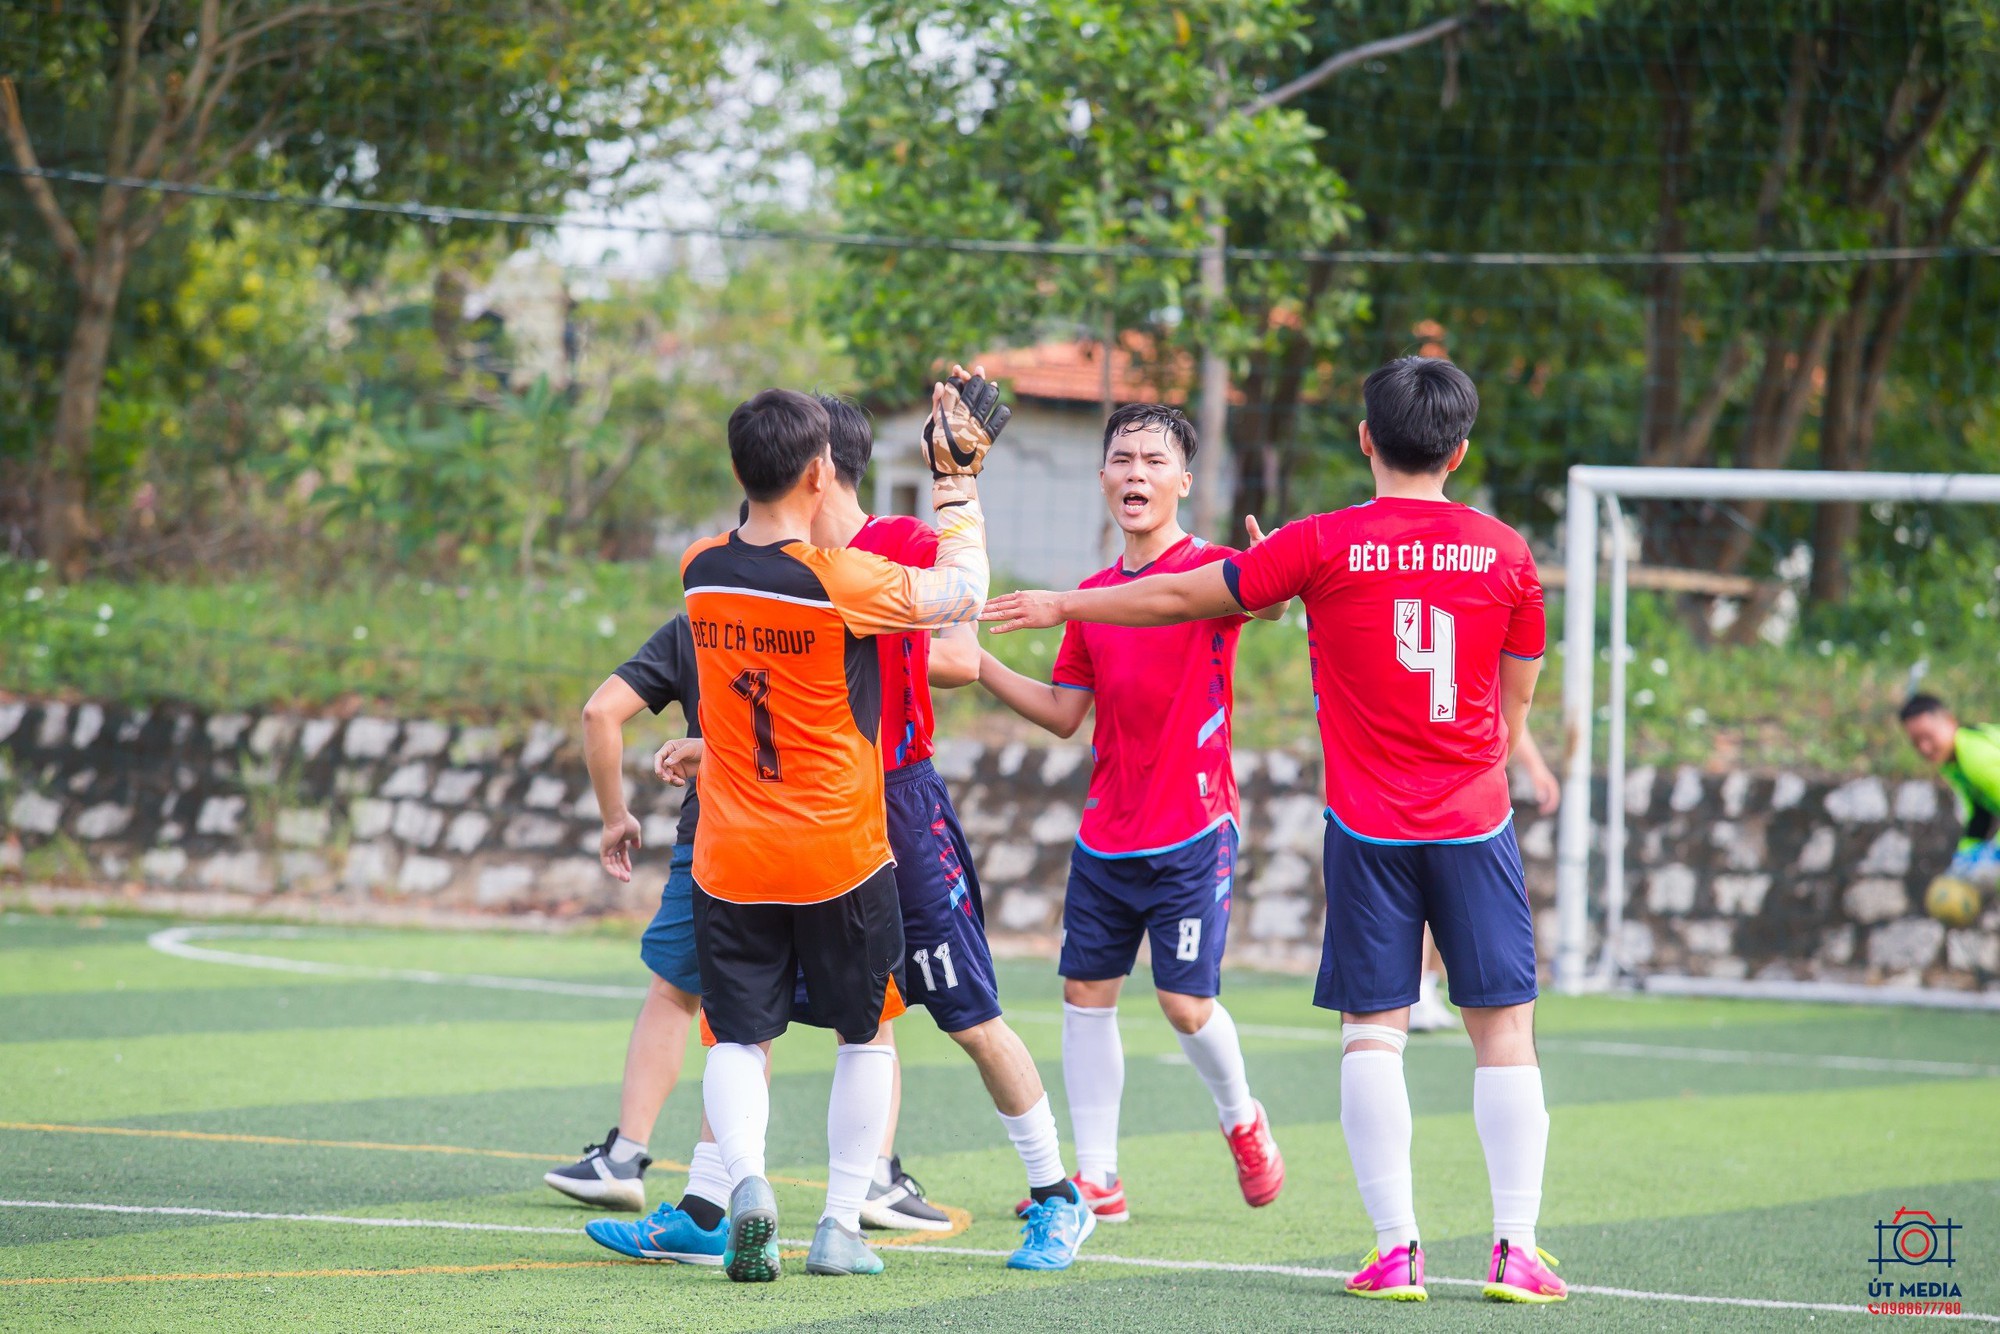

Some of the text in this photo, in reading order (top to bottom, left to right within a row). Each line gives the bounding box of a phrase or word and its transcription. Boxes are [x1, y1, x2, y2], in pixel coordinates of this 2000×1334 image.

[1348, 540, 1497, 573] ĐÈO CẢ GROUP
[724, 619, 746, 651] CẢ
[752, 627, 816, 655] GROUP
[1393, 599, 1458, 722] 4
[729, 667, 783, 782] 1
[1176, 917, 1202, 962] 8
[912, 942, 959, 992] 11
